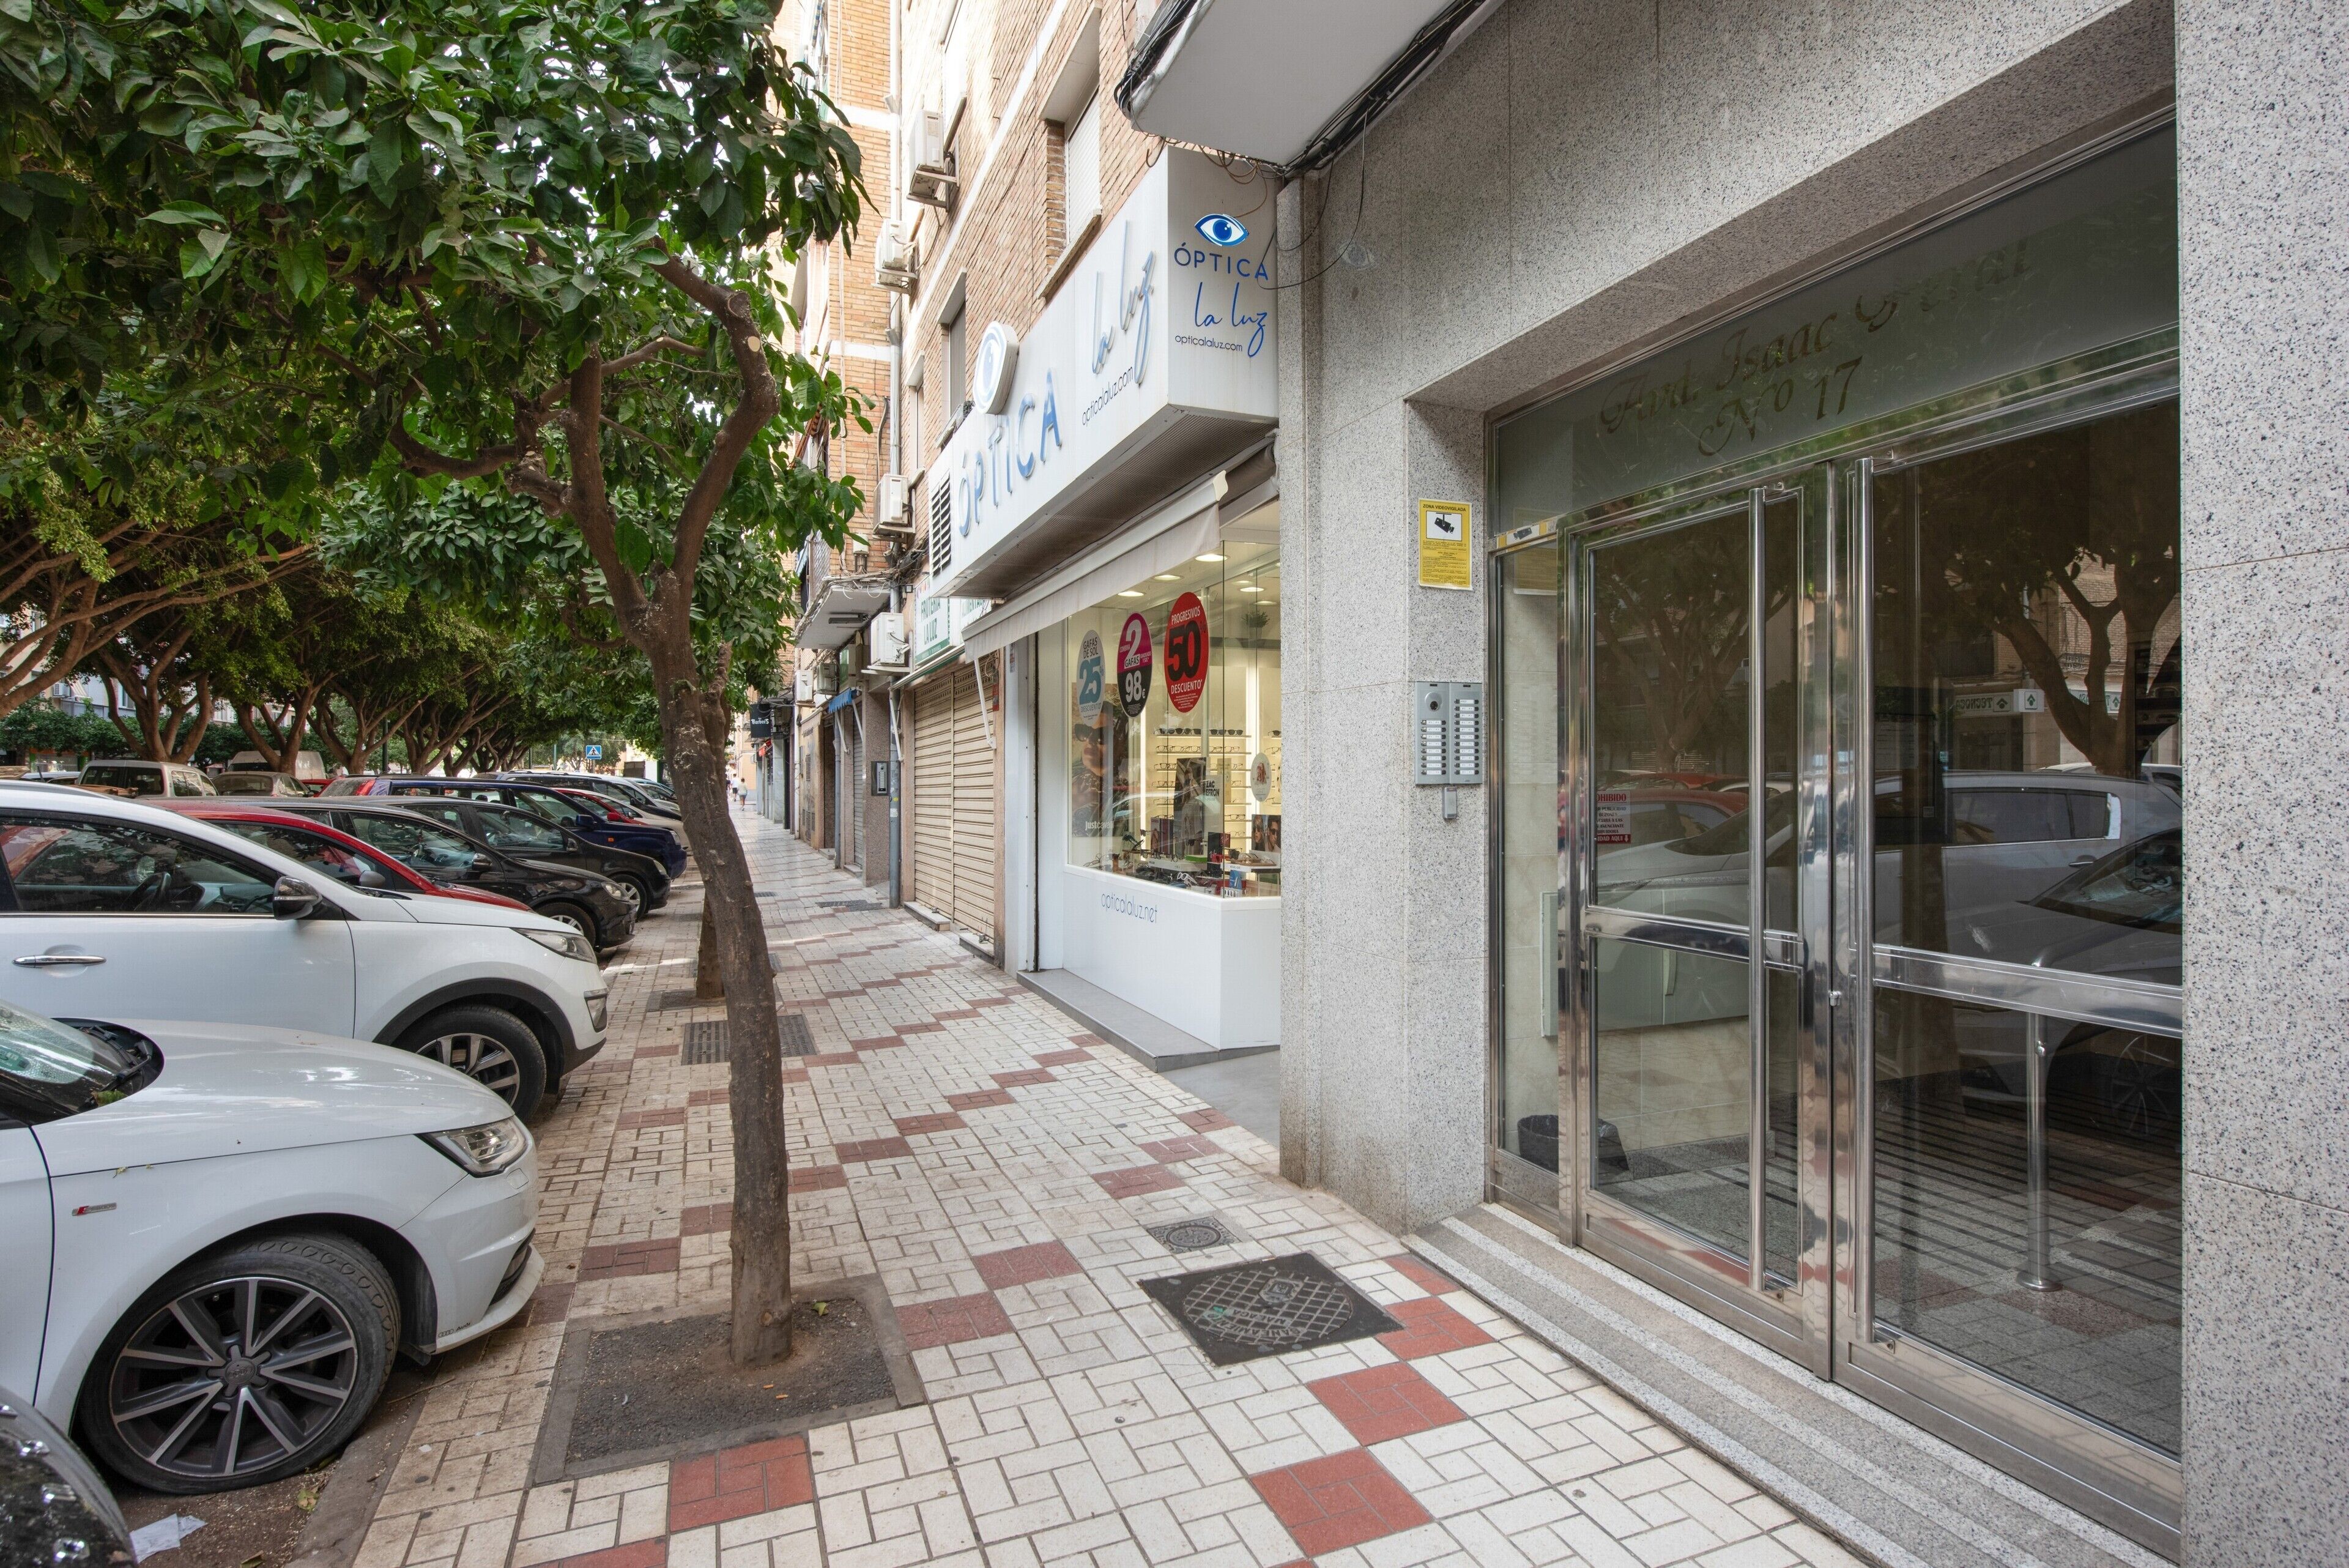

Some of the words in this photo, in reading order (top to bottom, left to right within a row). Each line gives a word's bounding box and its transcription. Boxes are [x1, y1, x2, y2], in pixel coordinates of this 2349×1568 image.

[1174, 242, 1268, 281] ÓPTICA
[1119, 220, 1156, 385] luz
[1195, 281, 1222, 327] la
[1232, 282, 1268, 358] luz
[1174, 335, 1243, 352] opticalaluz.com
[1716, 311, 1838, 388] Isaac
[1082, 366, 1134, 426] opticalaluz.com
[1816, 356, 1863, 420] 17
[959, 368, 1063, 538] ÓPTICA
[1171, 606, 1201, 625] PROGRESIVOS
[924, 623, 929, 645] LA
[1083, 637, 1098, 650] GAFAS
[1125, 619, 1142, 661] 2
[1083, 649, 1090, 659] DE
[1090, 647, 1099, 657] SOL
[1125, 656, 1140, 667] GAFAS
[1101, 893, 1157, 924] opticalaluz.net
[456, 1322, 470, 1332] Audi
